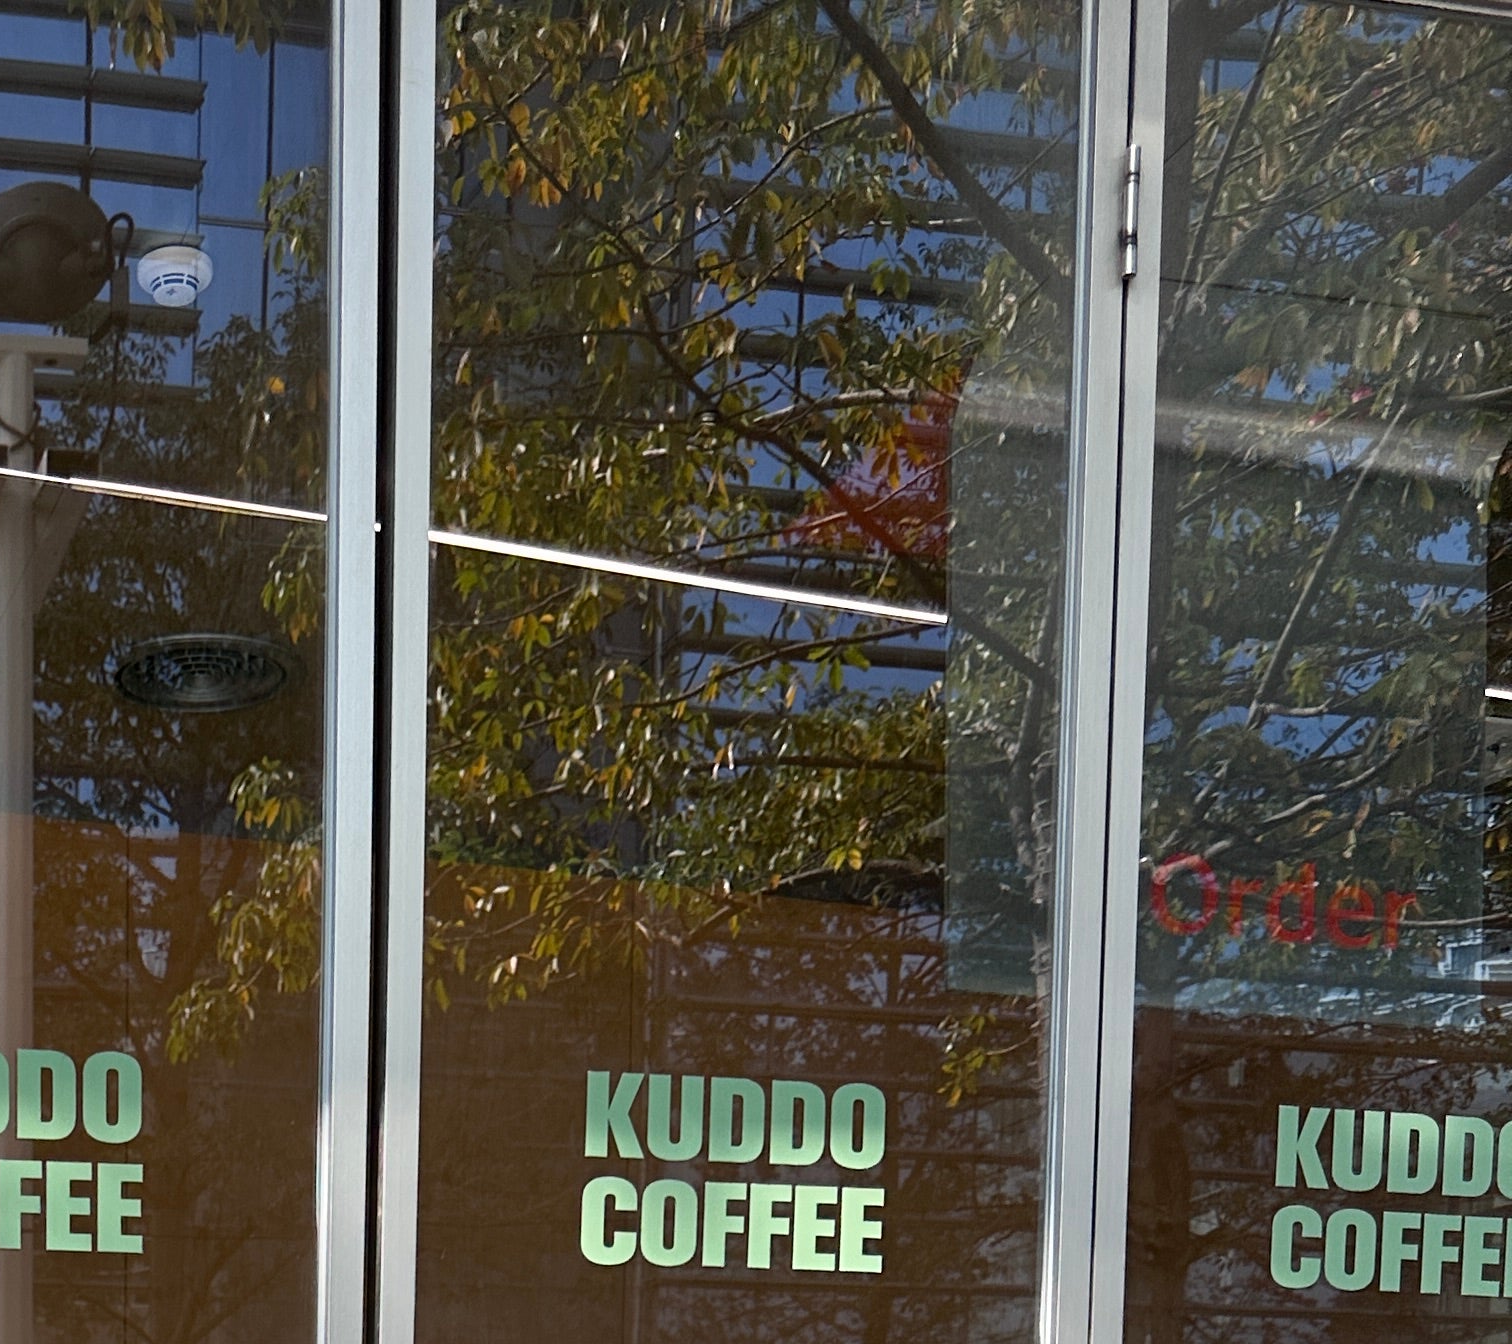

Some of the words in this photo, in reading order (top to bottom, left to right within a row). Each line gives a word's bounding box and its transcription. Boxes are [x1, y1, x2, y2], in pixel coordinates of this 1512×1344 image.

[1150, 852, 1418, 949] Order
[584, 1070, 887, 1171] KUDDO
[1274, 1104, 1512, 1199] KUDD
[580, 1175, 886, 1274] COFFEE
[1270, 1204, 1512, 1298] COFFE
